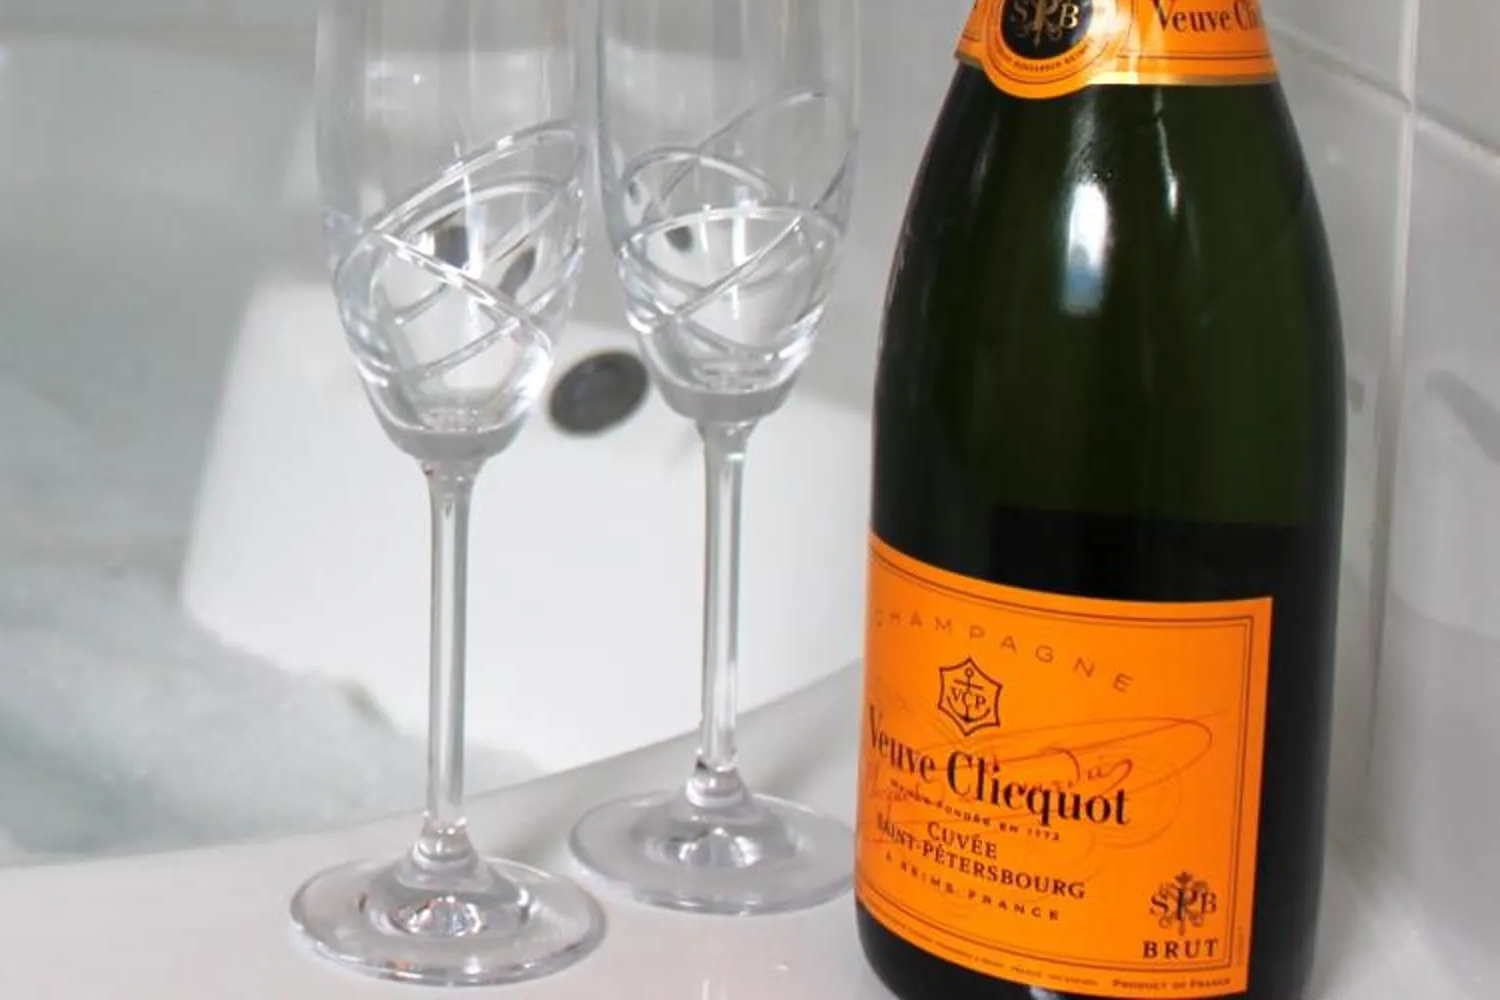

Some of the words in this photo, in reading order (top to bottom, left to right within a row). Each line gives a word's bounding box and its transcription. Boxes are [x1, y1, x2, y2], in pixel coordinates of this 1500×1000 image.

[875, 609, 1134, 693] CHAMPAGNE
[951, 687, 986, 710] VCP
[869, 704, 936, 783] Veuve
[947, 750, 1131, 826] Clicquot
[927, 822, 997, 860] CUVÉE
[968, 890, 1059, 920] FRANCE
[1143, 938, 1218, 959] BRUT
